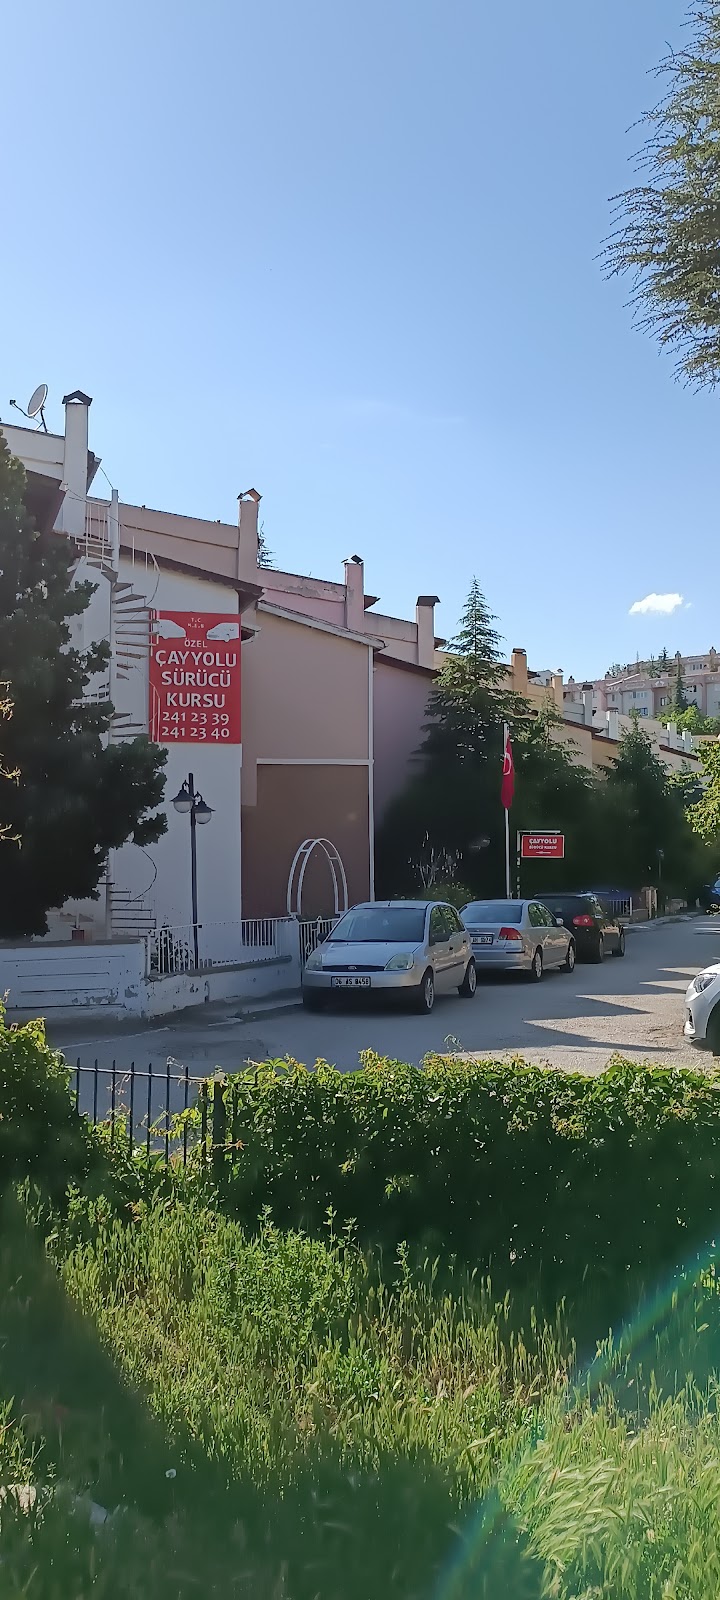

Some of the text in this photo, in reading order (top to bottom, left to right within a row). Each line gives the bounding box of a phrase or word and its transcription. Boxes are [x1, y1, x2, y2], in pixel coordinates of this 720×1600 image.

[184, 637, 208, 648] ÖZEL
[155, 649, 237, 667] ÇAYYOLU
[161, 667, 231, 687] SÜRÜCÜ
[166, 692, 226, 708] KURSU
[162, 711, 230, 726] 241 23 39
[161, 726, 230, 740] 241 23 40
